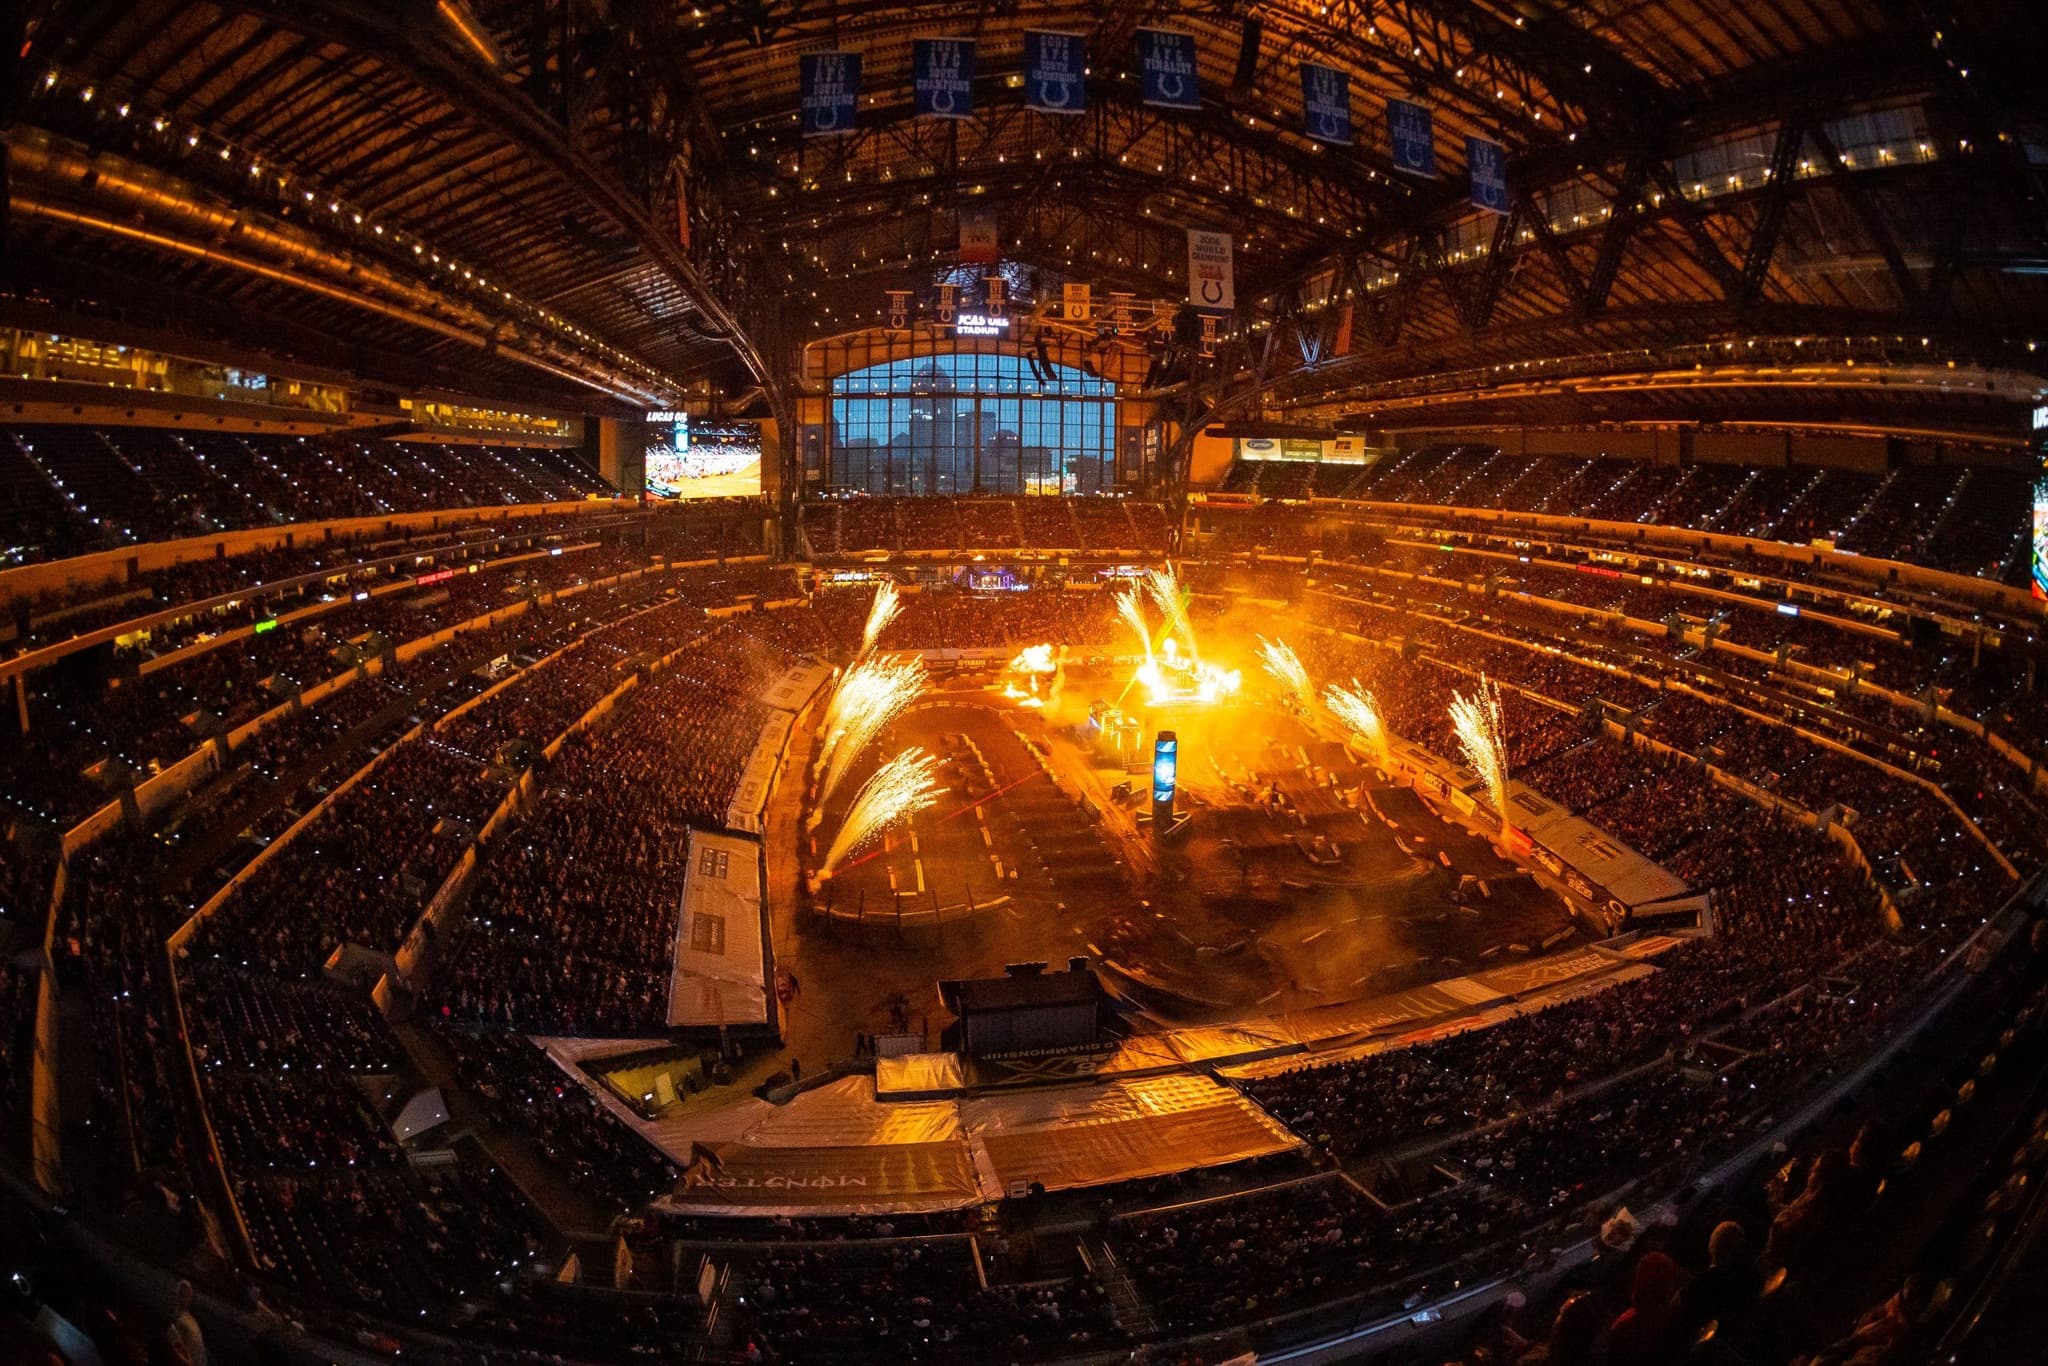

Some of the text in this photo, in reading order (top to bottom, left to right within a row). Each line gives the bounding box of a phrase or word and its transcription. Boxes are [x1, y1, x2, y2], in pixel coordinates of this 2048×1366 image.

[916, 80, 969, 92] CHAMPIONS
[957, 326, 999, 335] STADIUM
[646, 411, 688, 422] LUCAS OIL
[981, 1043, 1102, 1061] CHAMPIONSHIP
